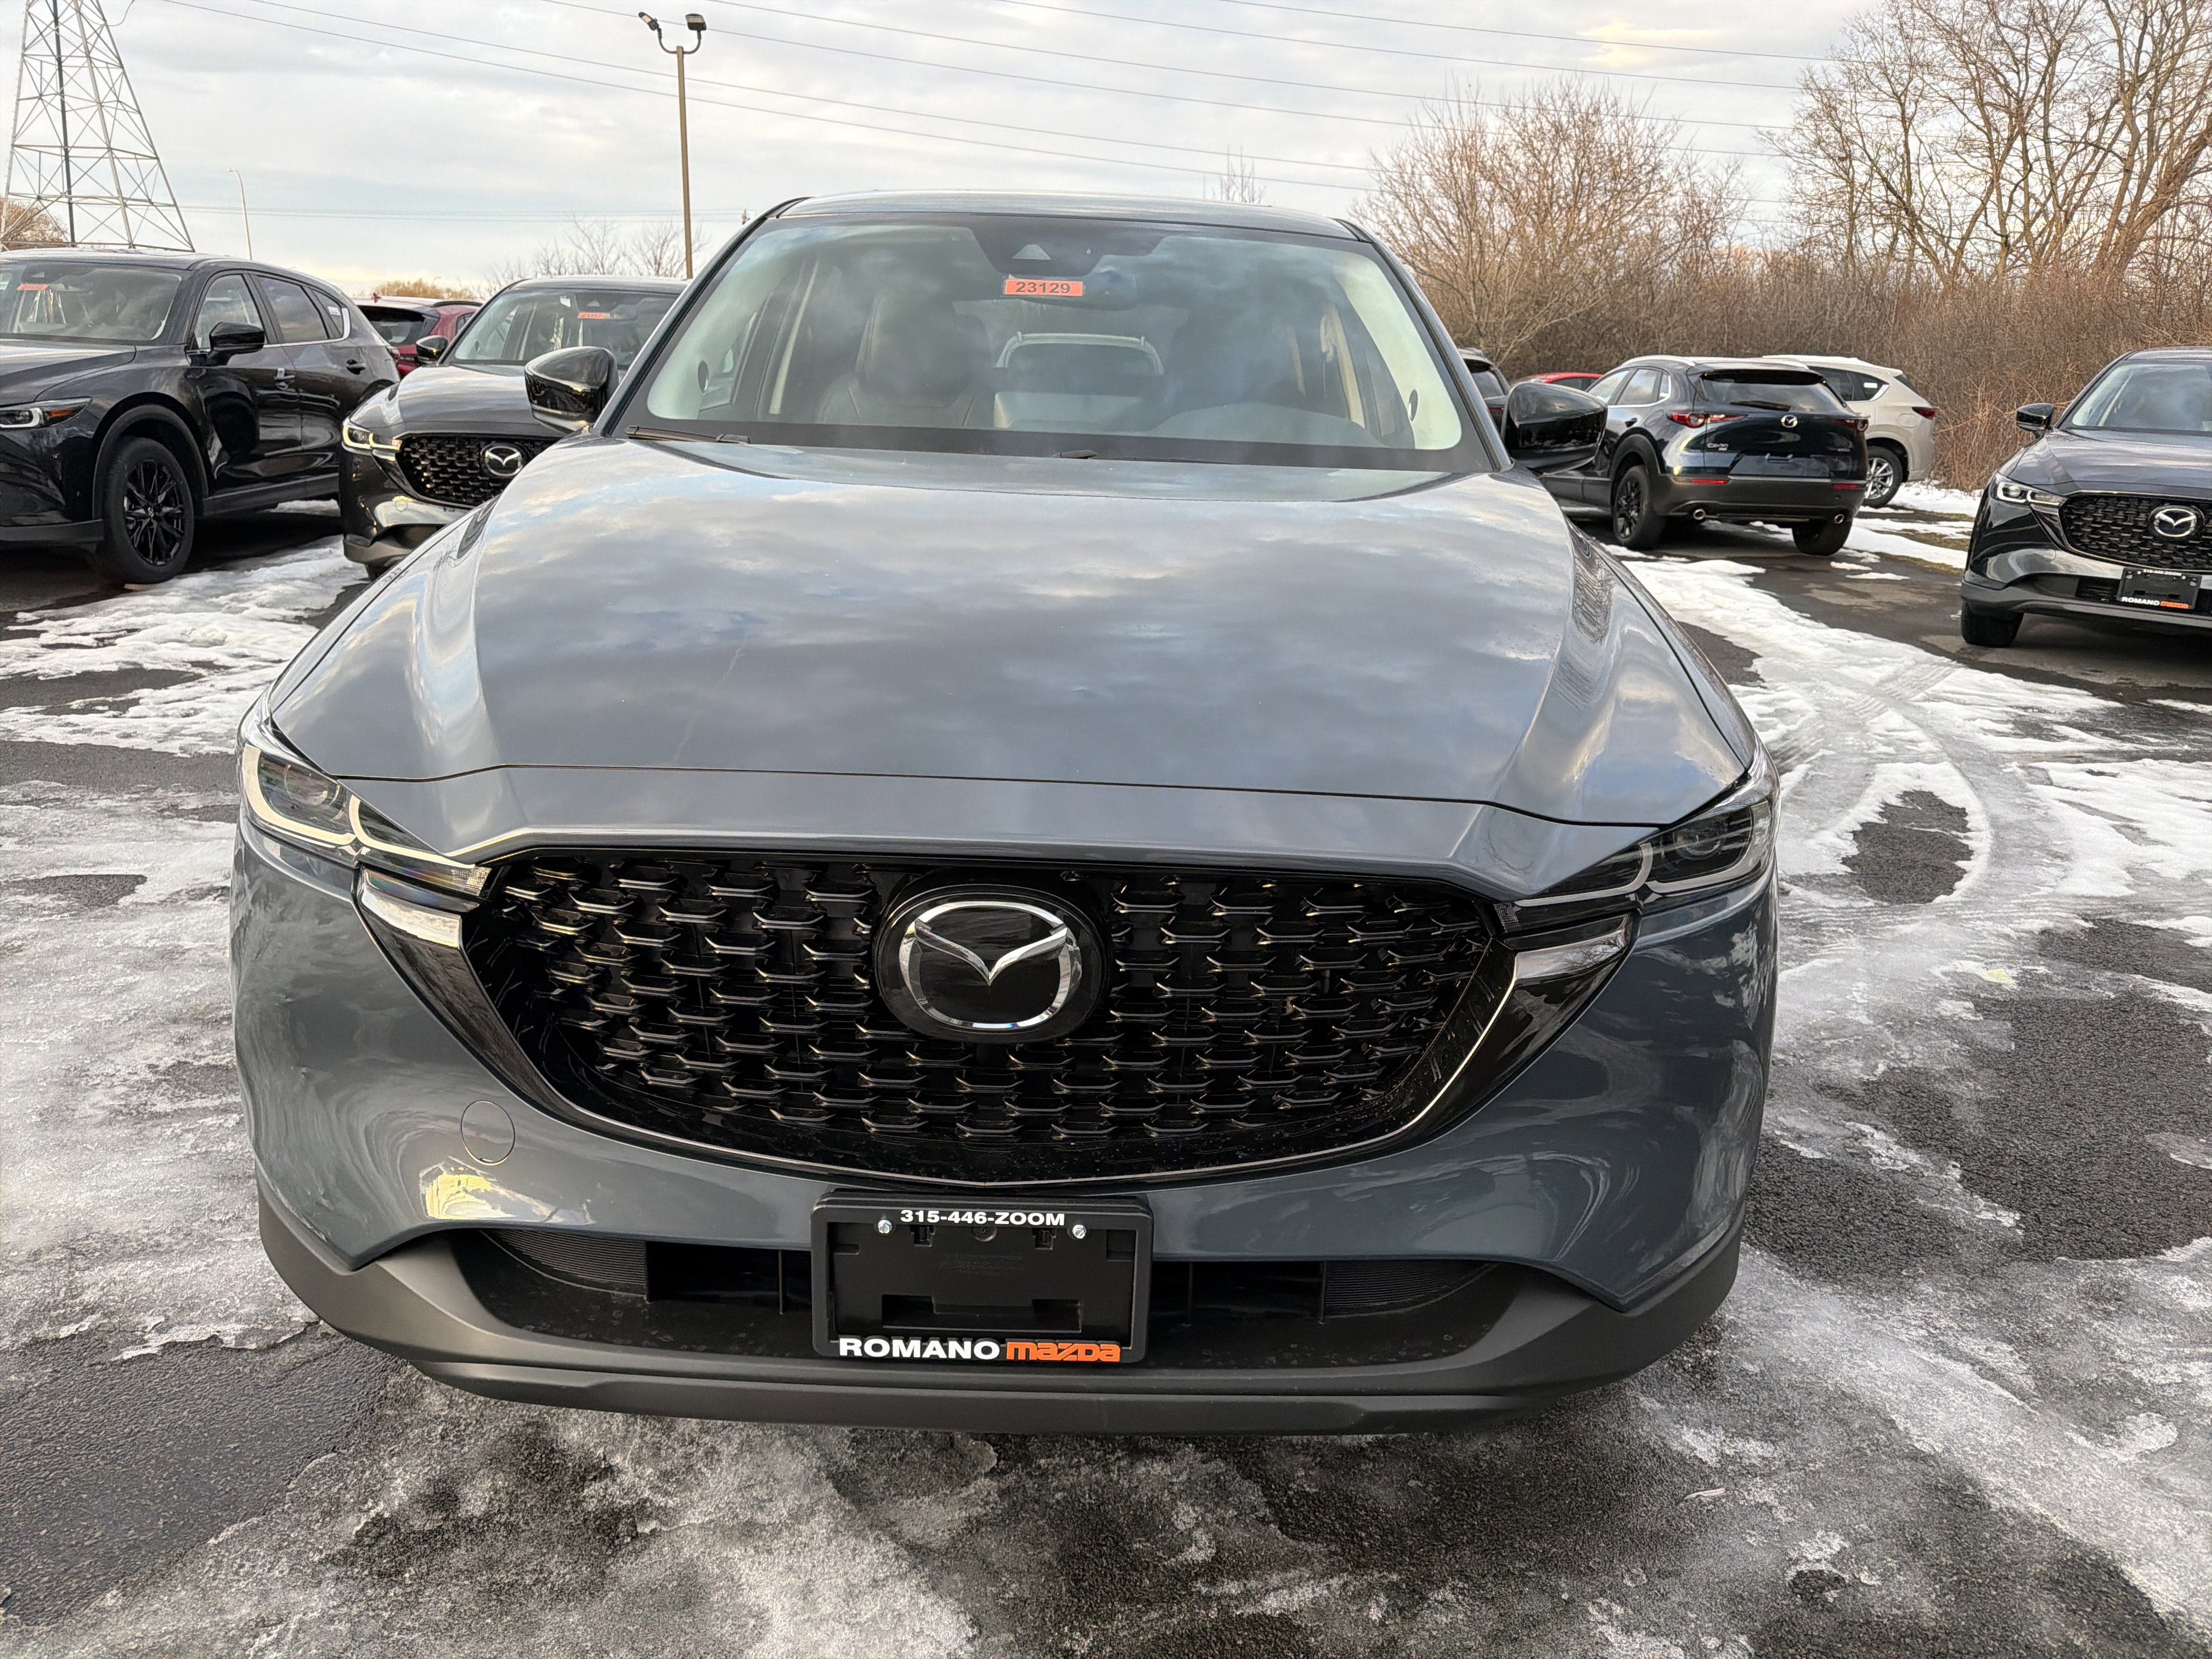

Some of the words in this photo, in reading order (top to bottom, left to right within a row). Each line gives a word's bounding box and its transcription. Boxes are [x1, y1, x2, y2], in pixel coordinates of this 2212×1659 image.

[1015, 281, 1071, 294] 23129
[2121, 596, 2160, 606] ROMANO
[900, 1209, 1065, 1226] 315-446-ZOOM
[839, 1338, 1000, 1360] ROMANO
[1006, 1341, 1121, 1363] mazda
